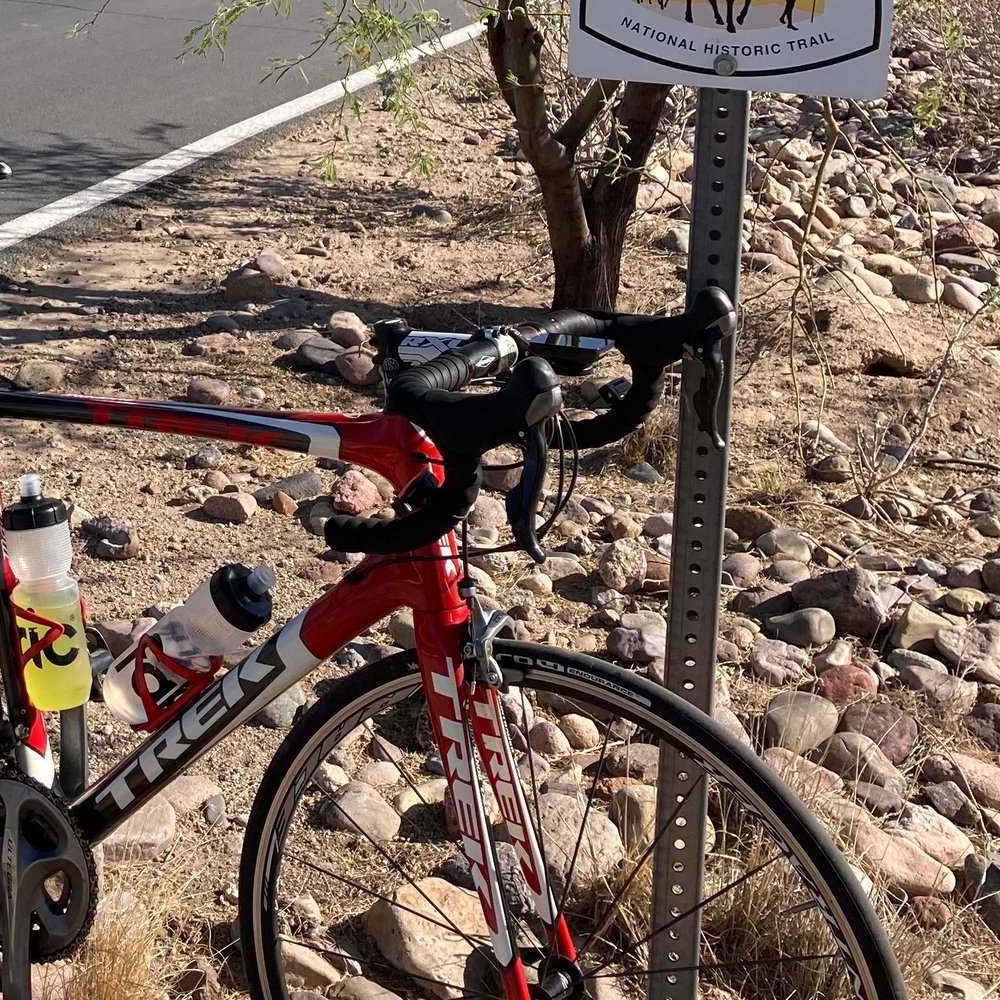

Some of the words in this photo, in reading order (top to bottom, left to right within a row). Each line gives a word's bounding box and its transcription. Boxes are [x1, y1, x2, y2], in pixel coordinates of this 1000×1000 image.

[620, 16, 698, 52] NATIONAL
[703, 42, 782, 58] HISTORIC
[786, 32, 835, 52] TRAIL
[93, 403, 283, 447] TREK
[94, 649, 277, 811] TREK
[568, 667, 636, 697] ENDURANCE
[431, 656, 499, 936] TREK
[474, 688, 541, 896] TREK
